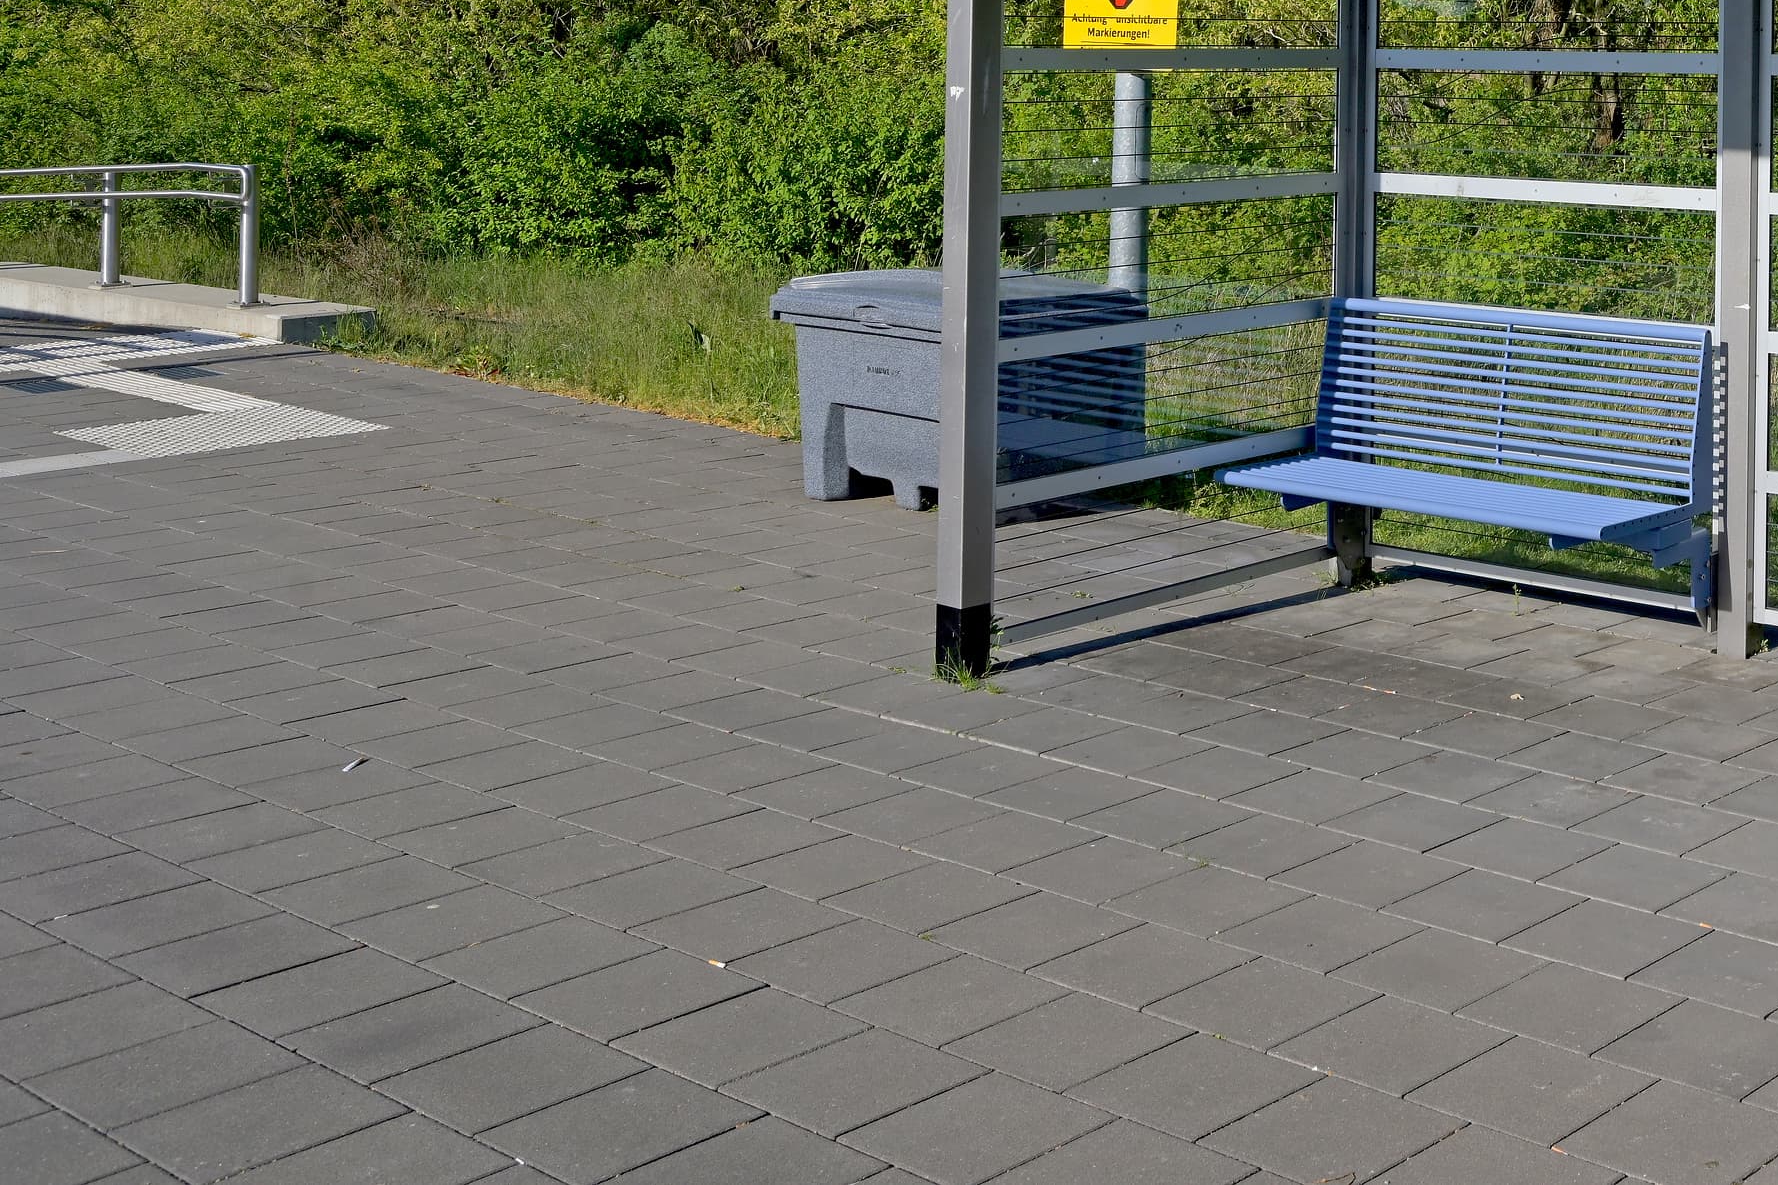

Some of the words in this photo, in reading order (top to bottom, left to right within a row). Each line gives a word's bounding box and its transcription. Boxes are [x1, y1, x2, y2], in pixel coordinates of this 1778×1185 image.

[1072, 13, 1107, 25] Achtung
[1116, 14, 1168, 25] unsichtbare
[1088, 28, 1150, 40] Markierungen!
